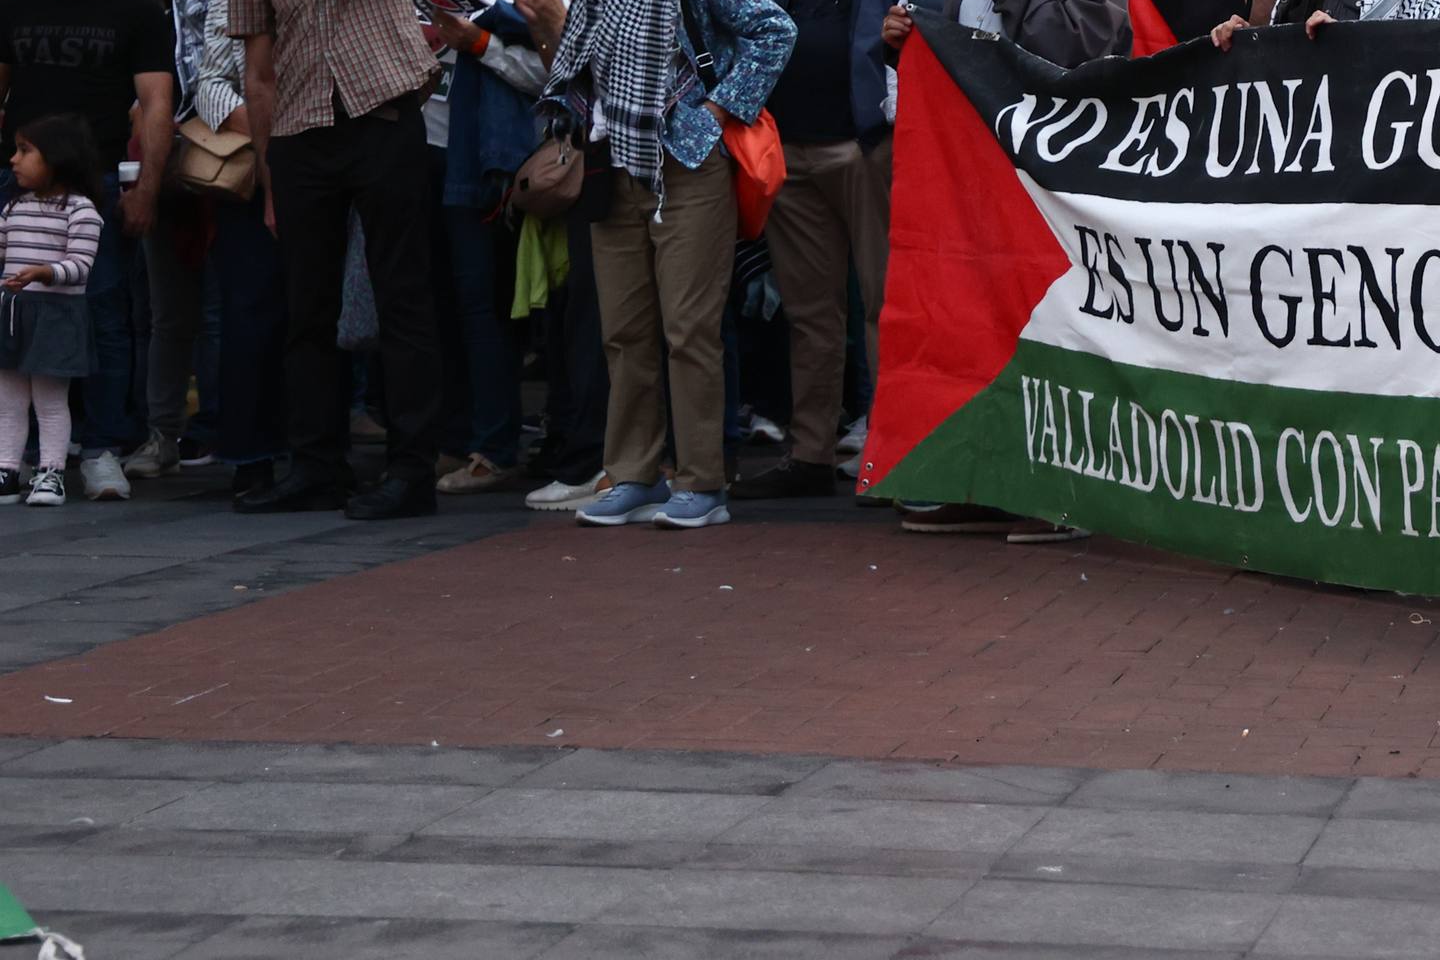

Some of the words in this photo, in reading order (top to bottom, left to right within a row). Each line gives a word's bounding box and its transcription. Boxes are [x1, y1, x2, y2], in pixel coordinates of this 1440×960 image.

[13, 37, 115, 67] FAST
[995, 93, 1108, 162] NO
[1099, 86, 1195, 178] ES
[1205, 74, 1335, 178] UNA
[1074, 224, 1134, 324] ES
[1135, 237, 1229, 338] UN
[1021, 375, 1264, 513] VALLADOLID
[1276, 427, 1384, 534] CON
